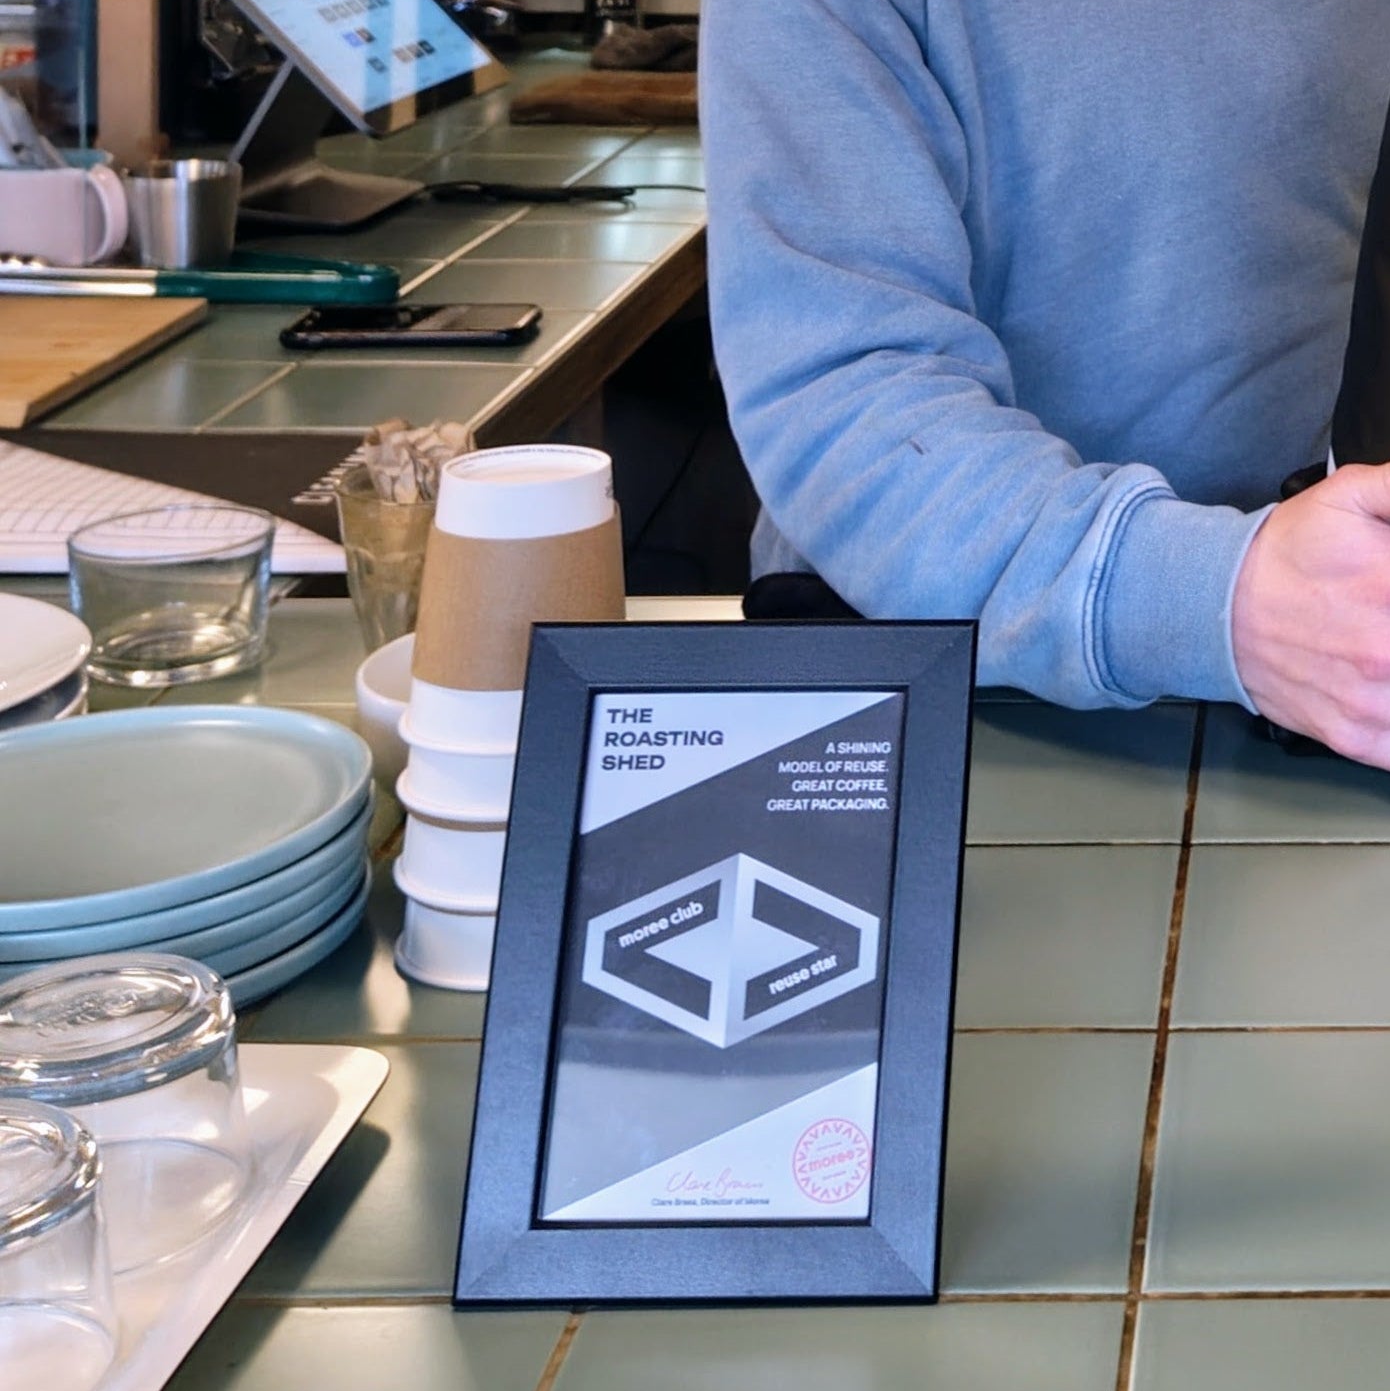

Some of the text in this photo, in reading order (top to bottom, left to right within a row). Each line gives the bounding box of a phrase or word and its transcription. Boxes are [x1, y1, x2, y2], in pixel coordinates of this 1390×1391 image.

[606, 708, 653, 724] THE
[603, 730, 724, 747] ROASTING
[825, 741, 892, 754] A SHINING
[601, 754, 666, 771] SHED
[778, 760, 889, 773] MODEL OF REUSE.
[791, 779, 835, 792] GREAT
[766, 797, 890, 811] GREAT PACKAGING.
[618, 901, 704, 948] moree club
[768, 954, 838, 994] reuse star
